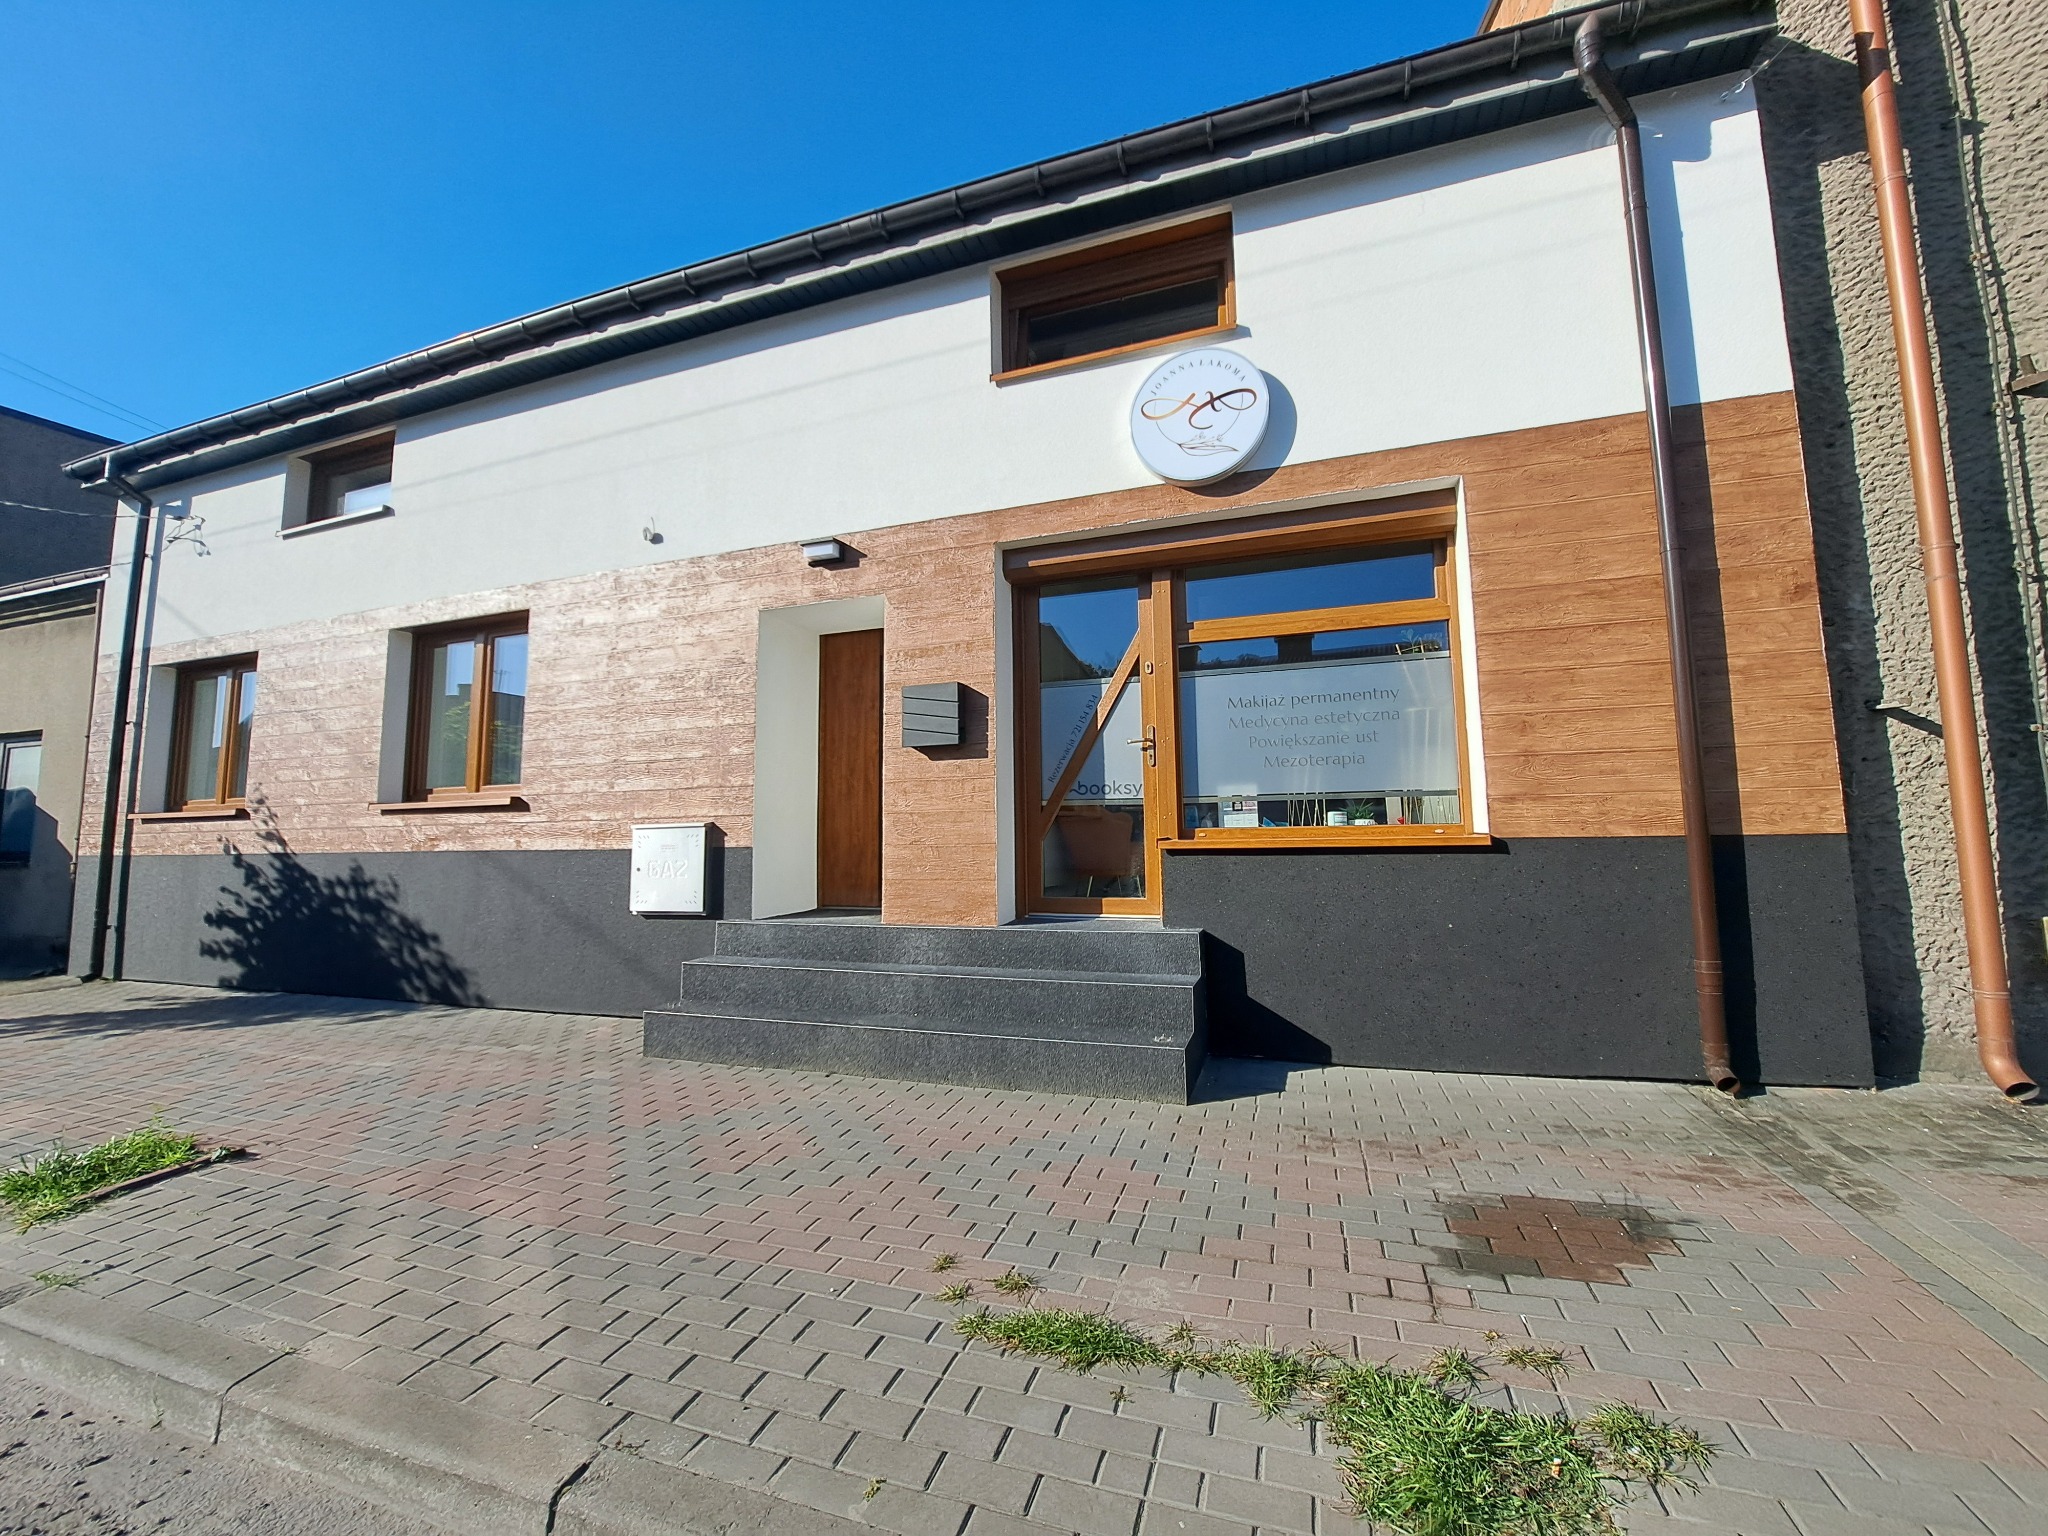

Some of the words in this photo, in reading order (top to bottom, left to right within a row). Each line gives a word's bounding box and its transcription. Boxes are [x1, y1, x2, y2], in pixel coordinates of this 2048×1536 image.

[1150, 360, 1194, 396] JOANNA
[1228, 693, 1286, 709] Makijaż
[1291, 687, 1400, 709] permanentny
[1228, 715, 1308, 731] Medycyna
[1314, 710, 1401, 726] estetyczna
[1047, 738, 1076, 784] Rezerwacja
[1070, 724, 1082, 738] 721
[1085, 694, 1098, 710] 834
[1249, 731, 1350, 749] Powiększanie
[1355, 730, 1379, 743] ust
[1263, 752, 1365, 768] Mezoterapia
[1070, 780, 1142, 797] booksy
[647, 859, 688, 879] GAZ
